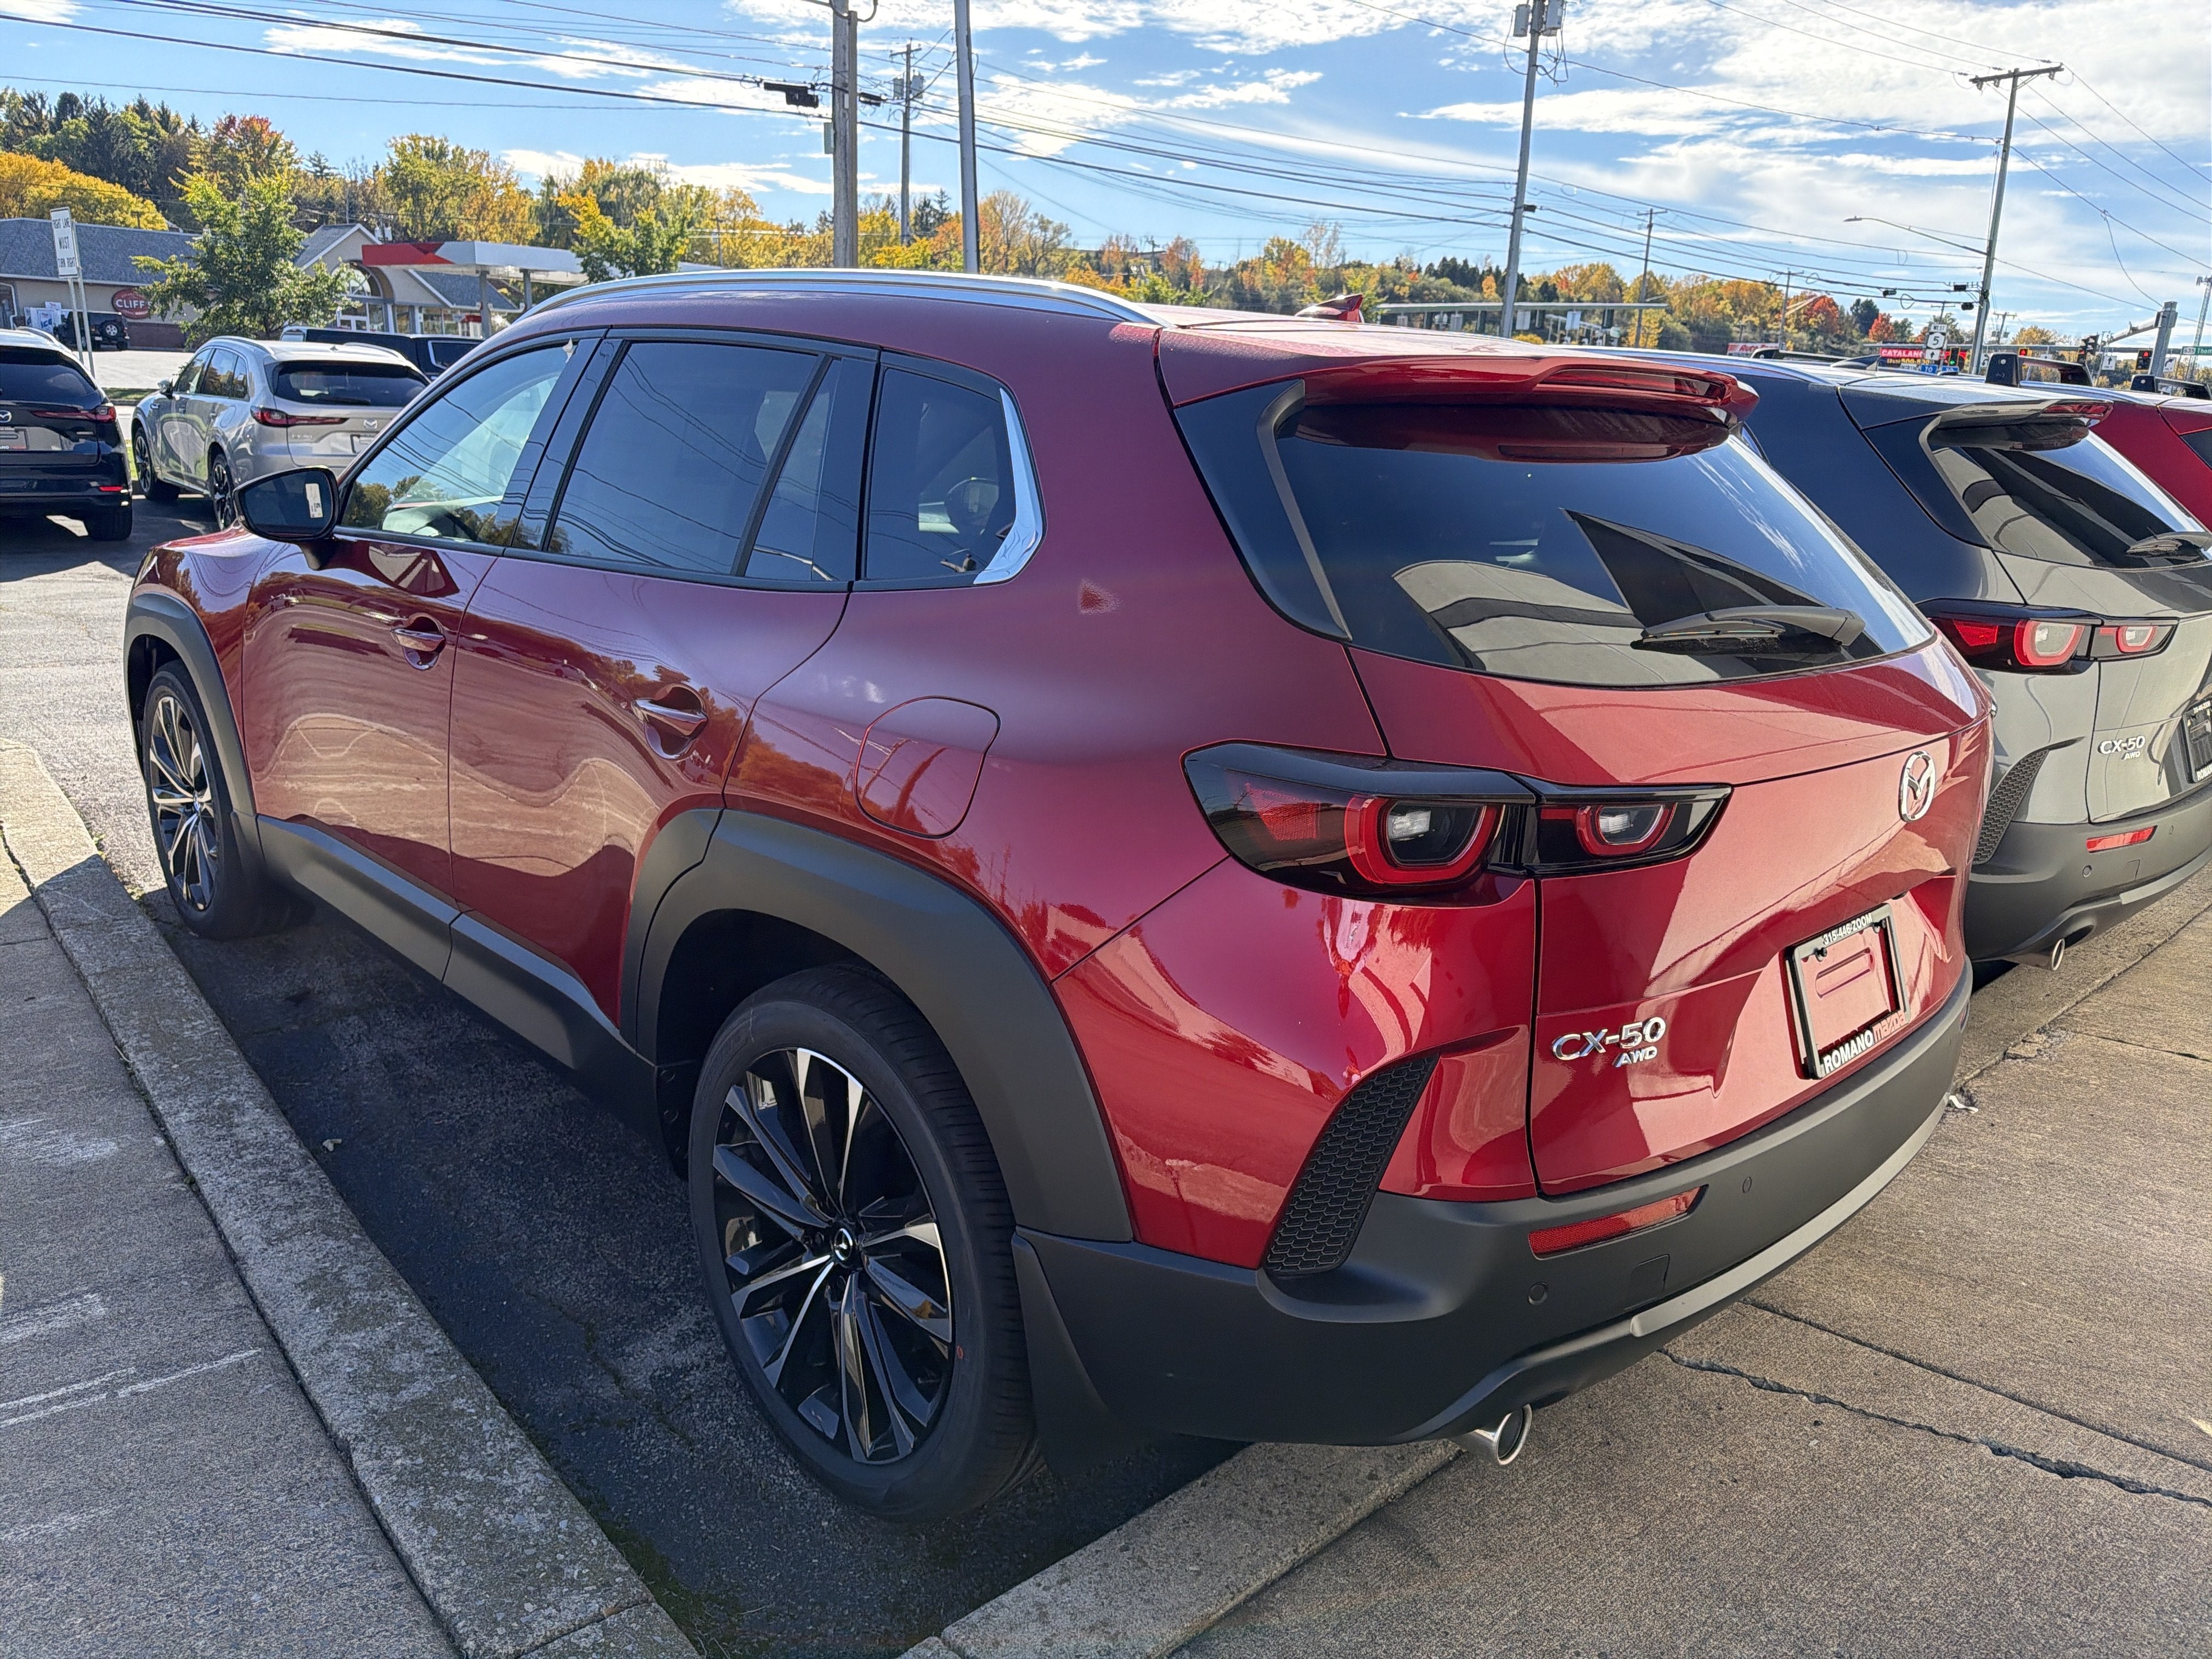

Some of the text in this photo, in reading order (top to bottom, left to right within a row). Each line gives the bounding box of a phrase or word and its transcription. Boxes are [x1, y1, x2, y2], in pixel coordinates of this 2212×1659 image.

[58, 236, 69, 249] MUST
[1932, 336, 1939, 345] 5
[2100, 736, 2145, 754] CX-50
[2123, 751, 2141, 760] AWD
[1822, 913, 1873, 946] 315-446-ZOOM
[1551, 1017, 1666, 1060] CX-50
[1612, 1046, 1657, 1068] AWD
[1823, 1029, 1874, 1074] ROMANO
